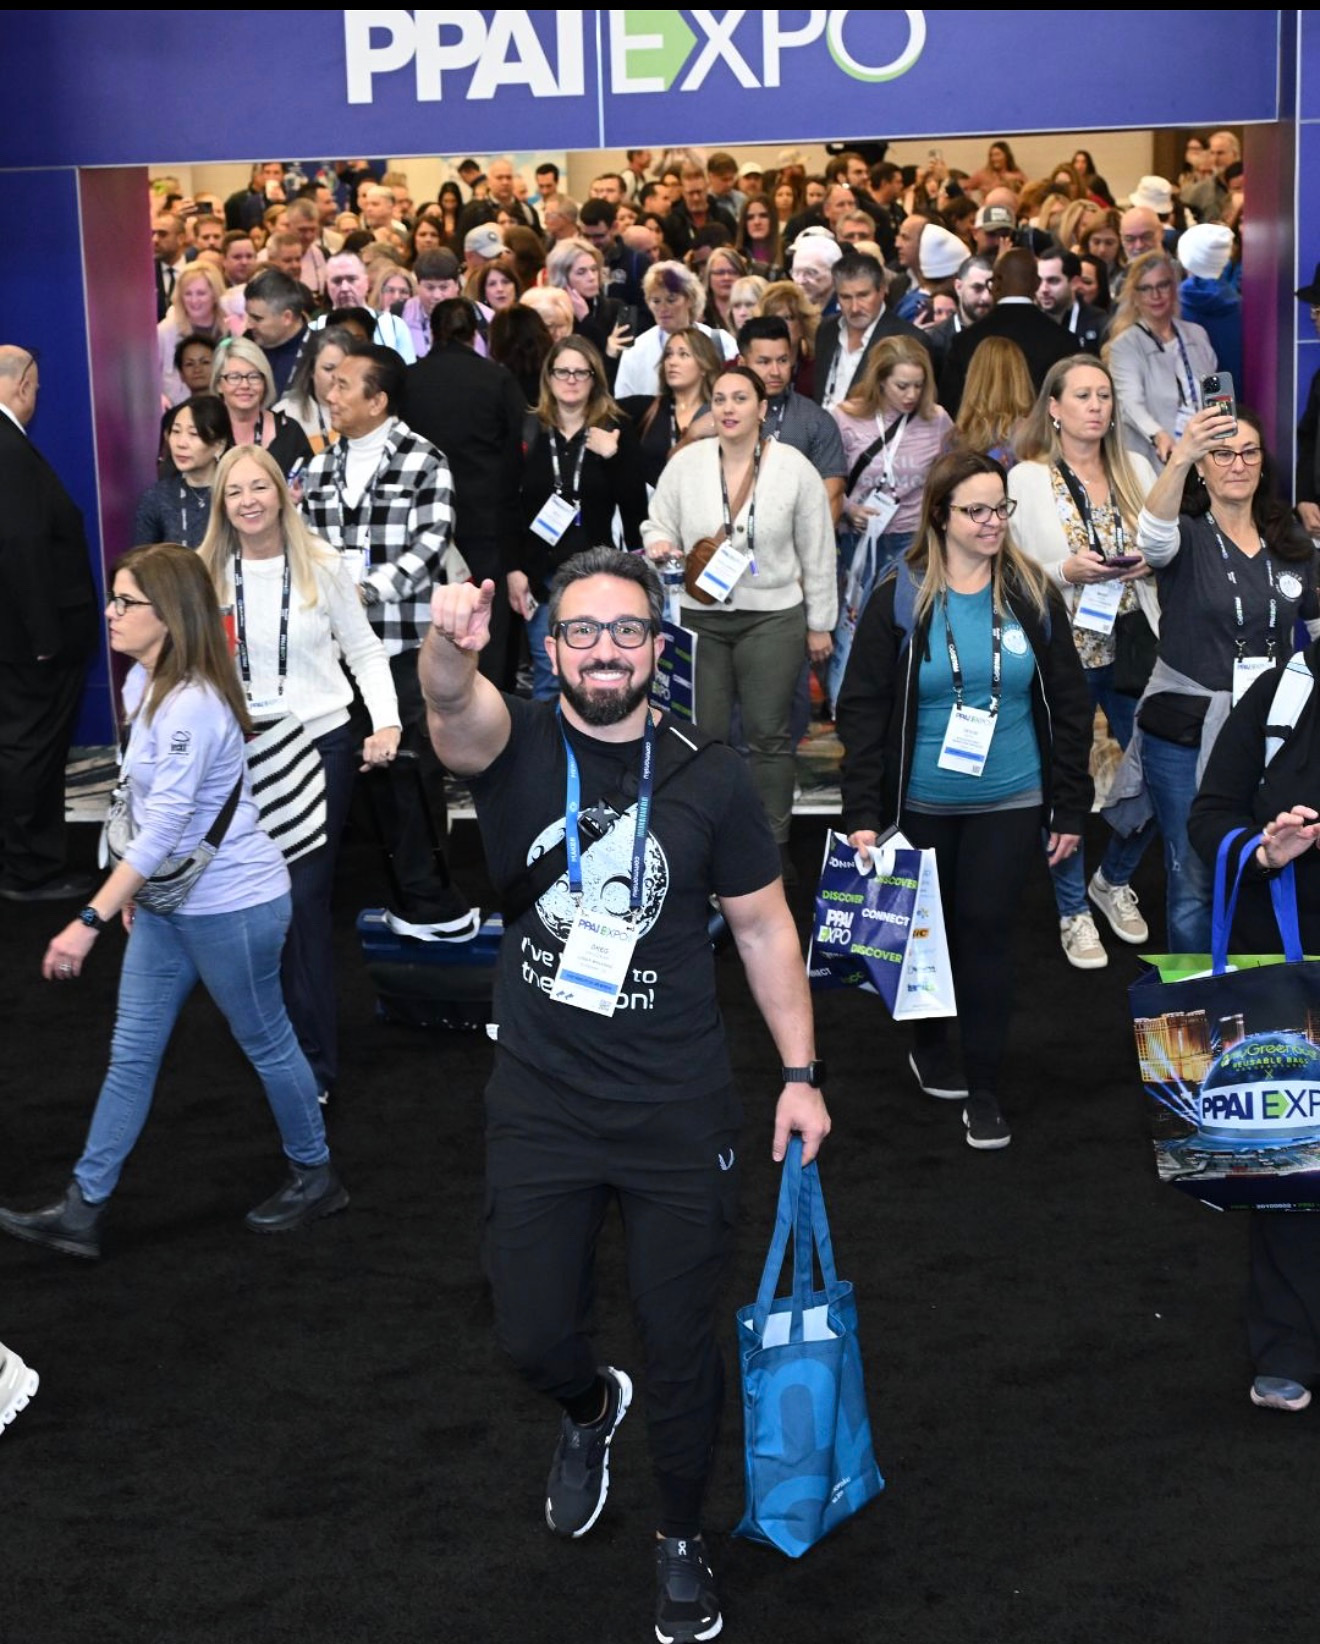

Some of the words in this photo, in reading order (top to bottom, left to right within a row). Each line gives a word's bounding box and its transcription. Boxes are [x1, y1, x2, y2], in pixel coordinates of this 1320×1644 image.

[343, 10, 585, 103] PPAI
[609, 10, 927, 94] EXPO
[822, 889, 865, 905] DISCOVER
[825, 909, 855, 928] PPAI
[861, 907, 911, 927] CONNECT
[577, 918, 601, 934] PPAI
[599, 925, 629, 941] EXPO
[817, 925, 852, 945] EXPO
[520, 936, 555, 968] I've
[632, 968, 658, 984] to
[851, 943, 903, 964] DISCOVER
[521, 960, 556, 995] the
[615, 988, 656, 1010] on!
[1232, 1056, 1282, 1068] REUSABLE
[1202, 1091, 1254, 1120] PPAI
[1262, 1089, 1320, 1120] EXP
